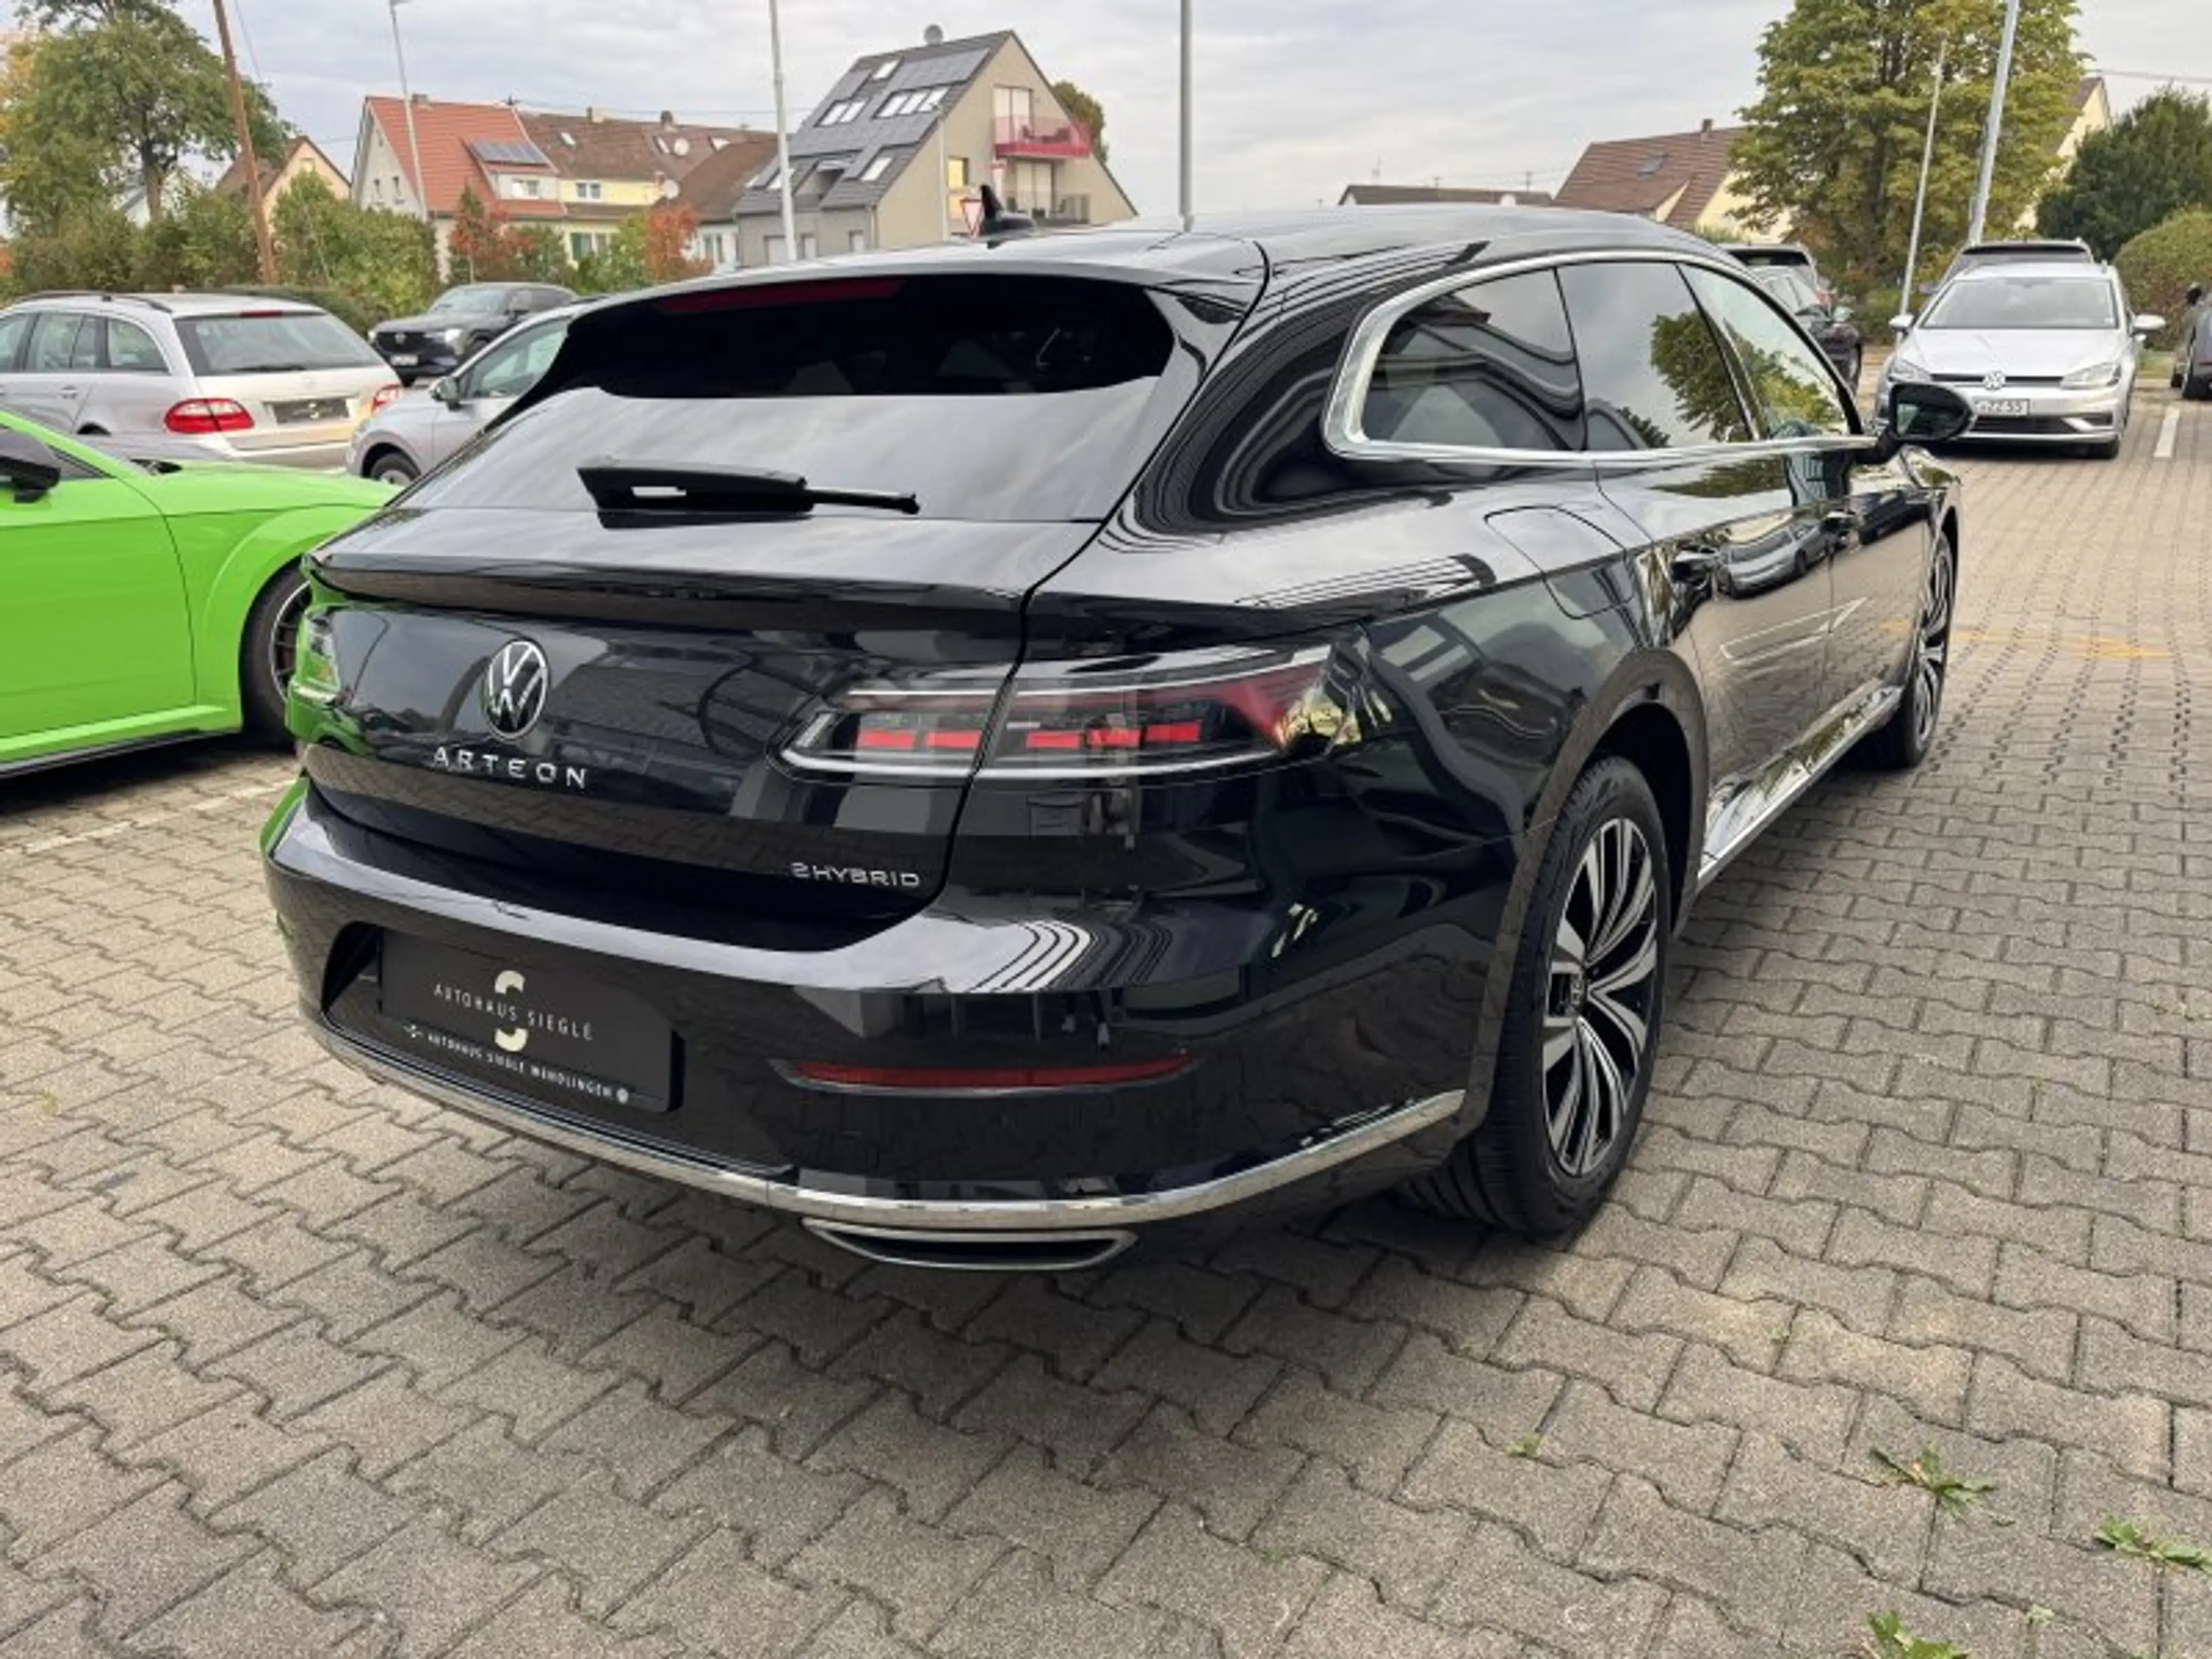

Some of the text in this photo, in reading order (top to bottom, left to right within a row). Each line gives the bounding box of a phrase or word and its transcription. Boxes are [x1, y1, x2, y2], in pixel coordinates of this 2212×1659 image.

[432, 747, 587, 788] ARTEON
[434, 983, 593, 1041] AUTOHAUS SIEGLE
[428, 1033, 483, 1060] AUTOHAUS
